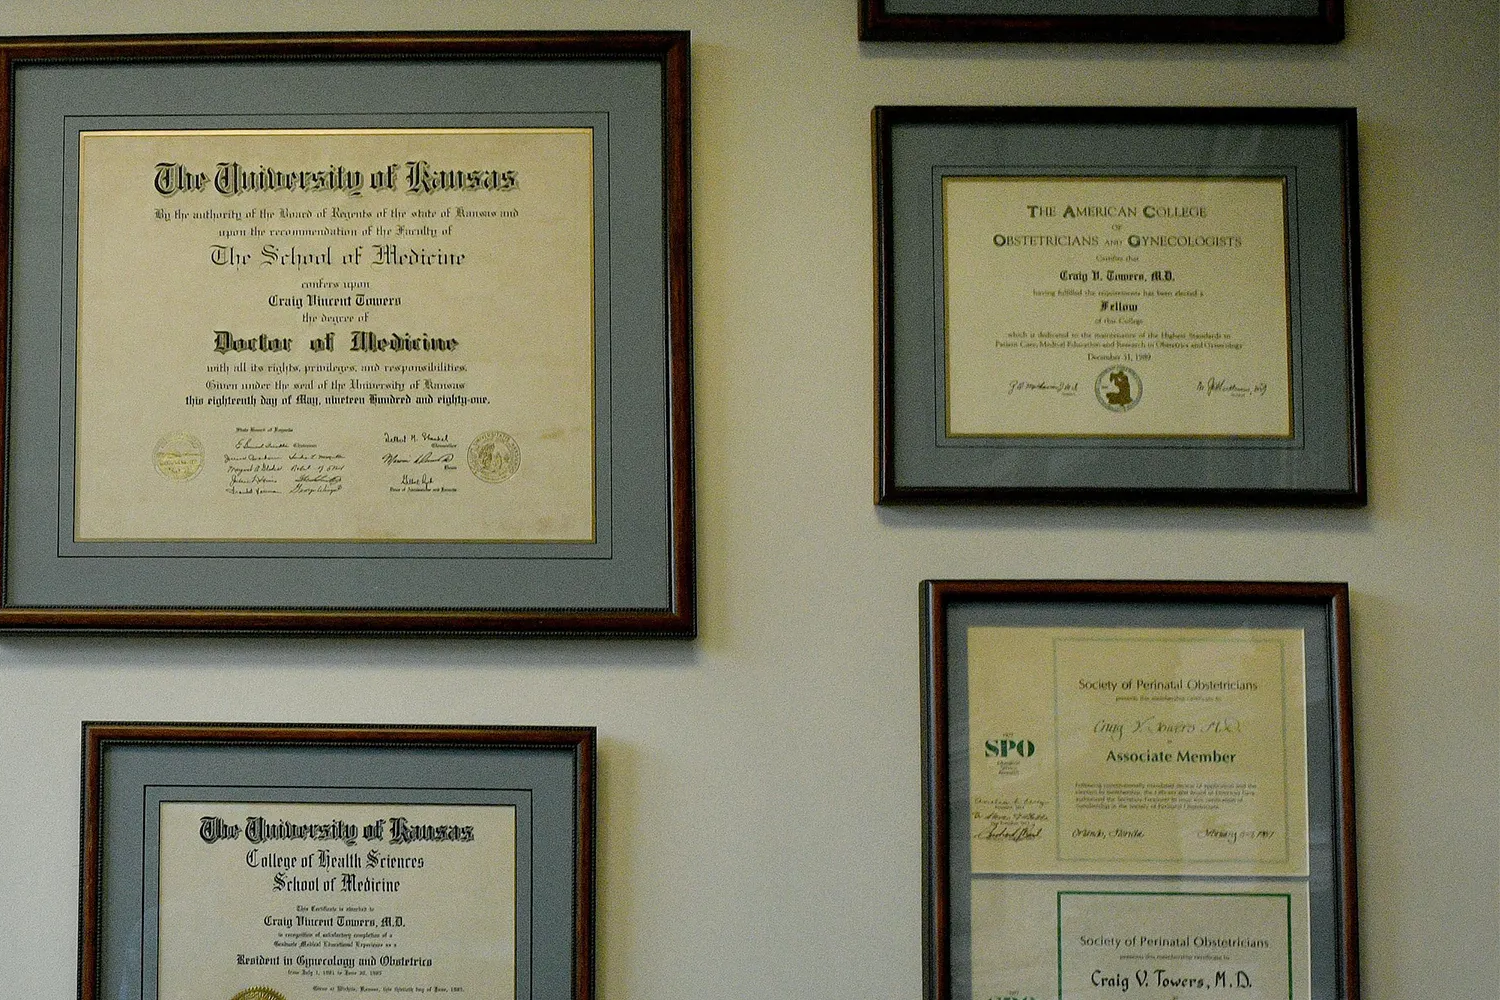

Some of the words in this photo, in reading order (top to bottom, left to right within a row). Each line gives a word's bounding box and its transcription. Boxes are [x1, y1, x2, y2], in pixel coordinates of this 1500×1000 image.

[154, 162, 211, 198] The
[214, 161, 364, 198] University
[370, 163, 399, 193] of
[405, 160, 520, 196] Kansas
[154, 208, 171, 221] By
[174, 209, 189, 221] the
[192, 209, 242, 222] authority
[245, 208, 257, 219] of
[259, 208, 275, 221] the
[279, 208, 313, 219] Board
[316, 208, 328, 219] of
[331, 207, 373, 221] Regents
[376, 208, 388, 218] of
[390, 208, 407, 220] the
[411, 208, 437, 218] state
[440, 207, 452, 218] of
[455, 207, 497, 219] Kansas
[500, 208, 519, 218] and
[1027, 205, 1056, 218] THE
[1062, 205, 1137, 218] AMERICAN
[1142, 205, 1208, 218] COLLEGE
[218, 229, 246, 239] upon
[250, 226, 266, 239] the
[269, 226, 357, 238] recommendation
[362, 226, 373, 236] of
[376, 225, 393, 238] the
[396, 225, 438, 239] Faculty
[441, 225, 453, 236] of
[992, 234, 1099, 247] OBSTETRICIANS
[1127, 234, 1242, 248] GYNECOLOGISTS
[209, 244, 251, 270] The
[258, 244, 332, 270] School
[342, 246, 364, 265] of
[371, 243, 466, 268] Medicine
[1060, 269, 1088, 282] Craig
[1091, 270, 1102, 281] V.
[1106, 270, 1147, 282] Towers,
[1151, 270, 1175, 281] M.D.
[268, 294, 303, 309] Craig
[307, 294, 352, 307] Vincent
[355, 294, 402, 307] Towers
[1100, 300, 1138, 312] Fellow
[301, 312, 318, 325] the
[320, 313, 354, 325] degree
[357, 312, 370, 323] of
[213, 330, 293, 355] Doctor
[310, 332, 335, 353] of
[350, 330, 460, 353] Medicine
[205, 380, 238, 390] Given
[241, 380, 271, 390] under
[275, 380, 290, 392] the
[293, 379, 314, 389] seal
[317, 379, 329, 390] of
[331, 379, 346, 391] the
[349, 379, 405, 391] University
[409, 379, 420, 390] of
[424, 379, 466, 390] Kansas
[185, 395, 204, 406] this
[207, 395, 257, 407] eighteenth
[260, 395, 278, 406] day
[281, 395, 292, 405] of
[295, 395, 321, 406] May,
[325, 395, 366, 405] nineteen
[369, 394, 412, 407] Hundred
[415, 395, 434, 405] and
[1078, 680, 1117, 692] Society
[1121, 679, 1133, 690] of
[1136, 680, 1183, 691] Perinatal
[1187, 679, 1258, 691] Obstetricians
[985, 740, 1035, 757] SPO
[1106, 750, 1172, 763] Associate
[1176, 750, 1236, 763] Member
[200, 816, 242, 844] The
[245, 816, 358, 846] University
[362, 819, 386, 842] of
[388, 817, 475, 845] Kansas
[246, 849, 297, 870] College
[301, 854, 314, 867] of
[318, 849, 362, 872] Health
[366, 849, 424, 868] Sciences
[272, 872, 319, 892] School
[323, 877, 336, 892] of
[341, 873, 400, 892] Medicine
[264, 916, 293, 928] Craig
[296, 916, 333, 926] Vincent
[337, 916, 378, 928] Towers,
[381, 916, 405, 927] M.D.
[1080, 935, 1120, 949] Society
[1125, 935, 1136, 948] of
[1141, 936, 1190, 948] Perinatal
[1193, 936, 1269, 949] Obstetricians
[236, 954, 280, 966] Resident
[283, 955, 293, 965] in
[296, 955, 355, 968] Gynecology
[359, 956, 376, 966] and
[380, 955, 433, 967] Obstetrics
[1091, 969, 1129, 992] Craig
[1135, 969, 1149, 987] V.
[1154, 969, 1210, 990] Towers,
